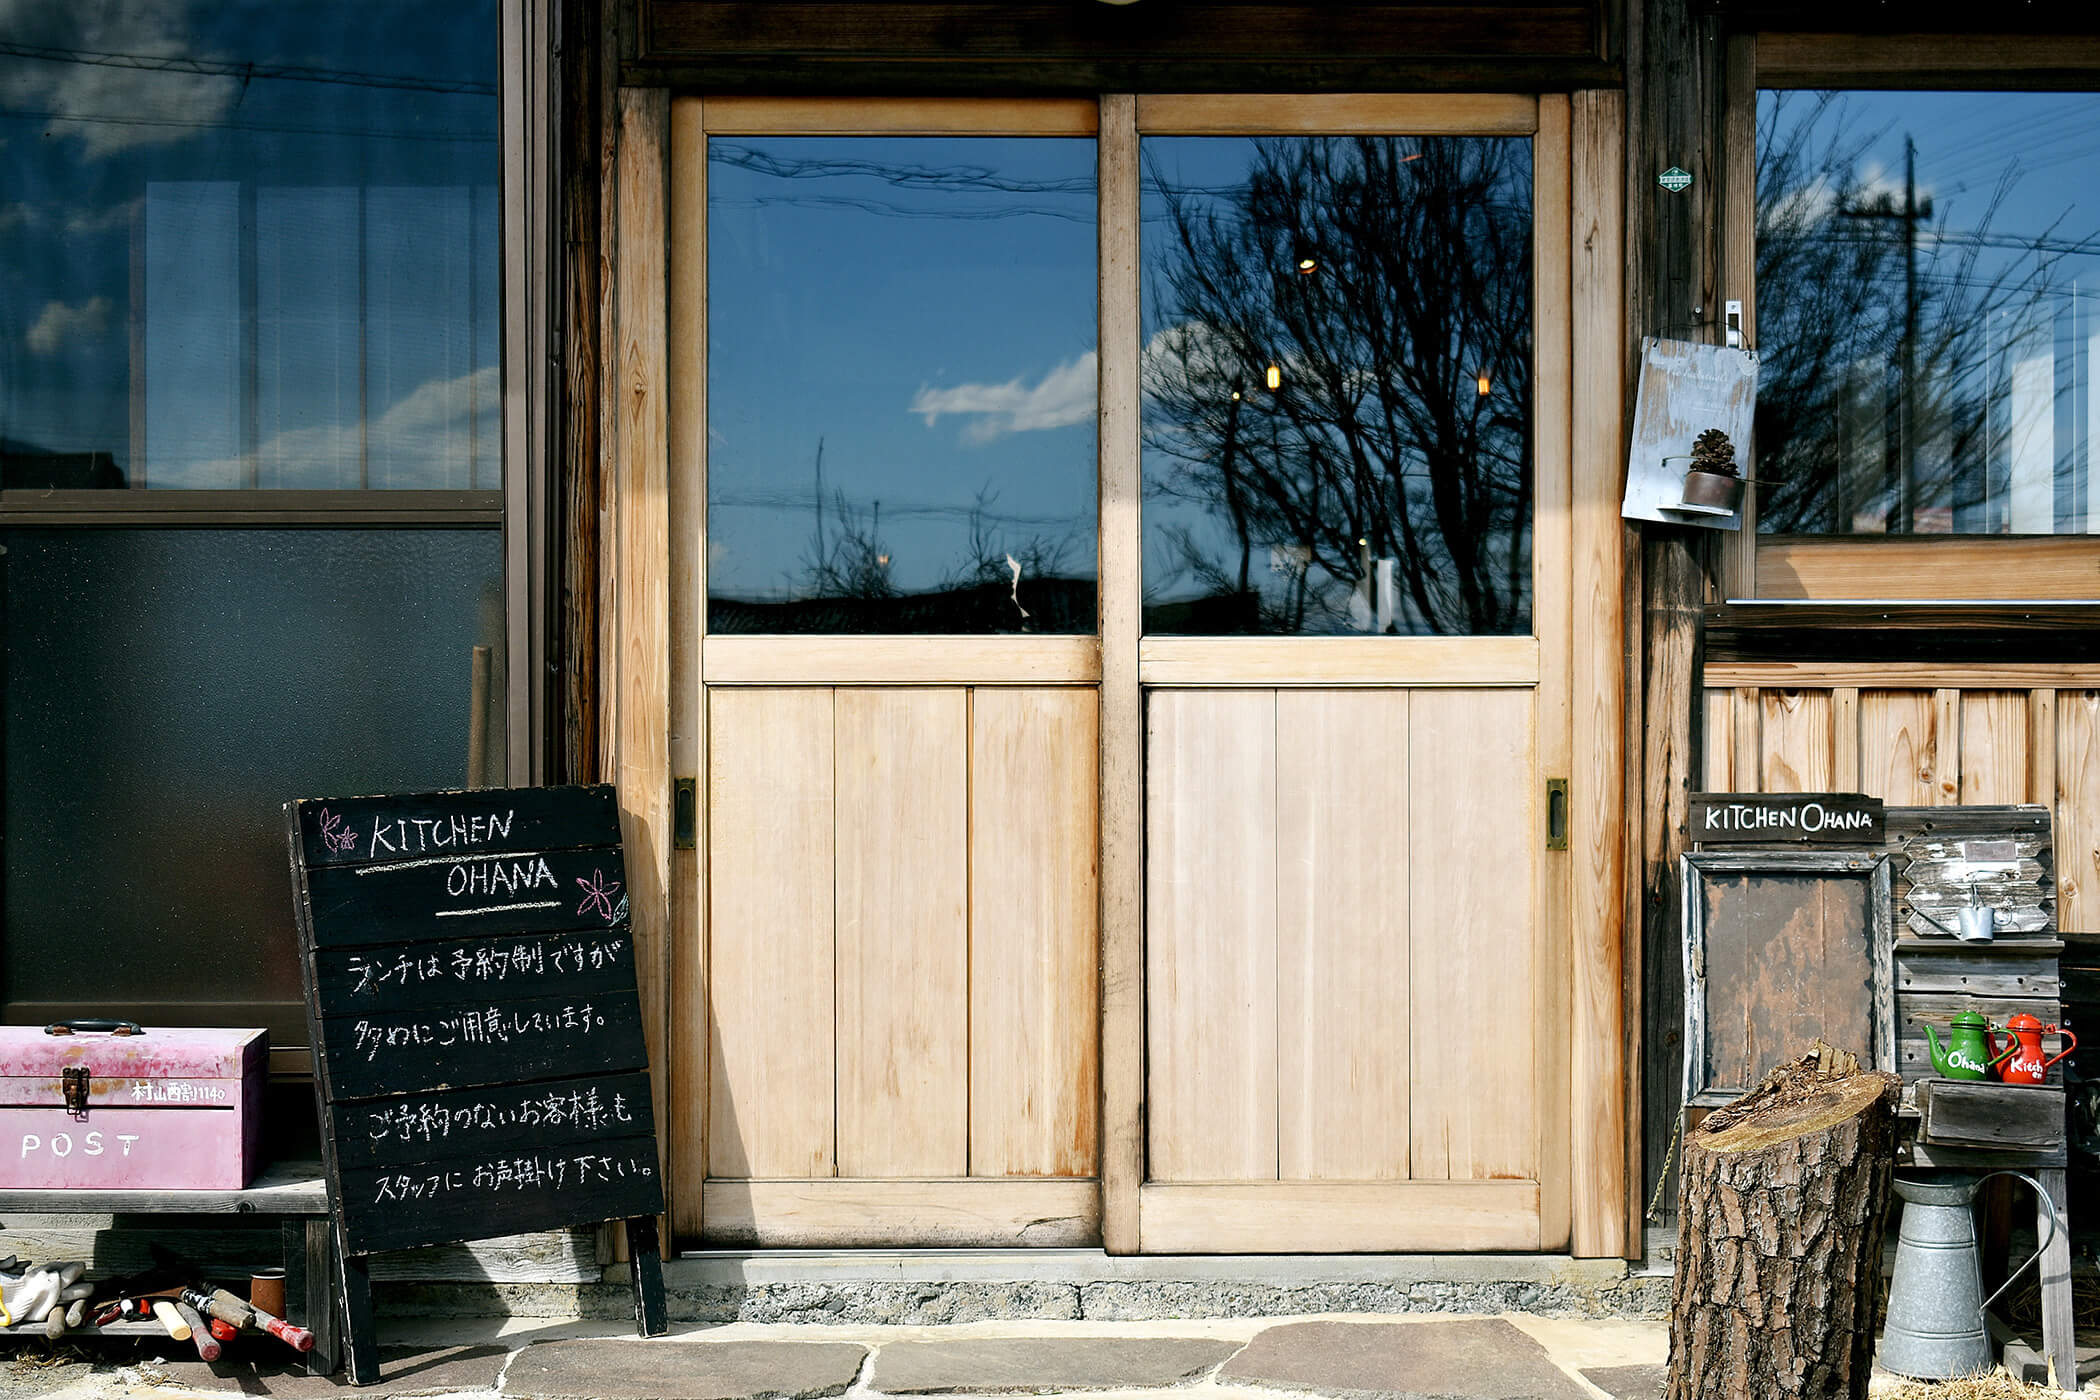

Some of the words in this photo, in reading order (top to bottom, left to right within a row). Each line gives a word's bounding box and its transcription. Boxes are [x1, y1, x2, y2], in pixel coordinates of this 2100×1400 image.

[1704, 804, 1797, 830] KITCHEN
[370, 809, 515, 858] KITCHEN
[446, 857, 559, 898] OHANA
[1947, 1051, 1986, 1074] Ohana
[21, 1131, 140, 1159] POST
